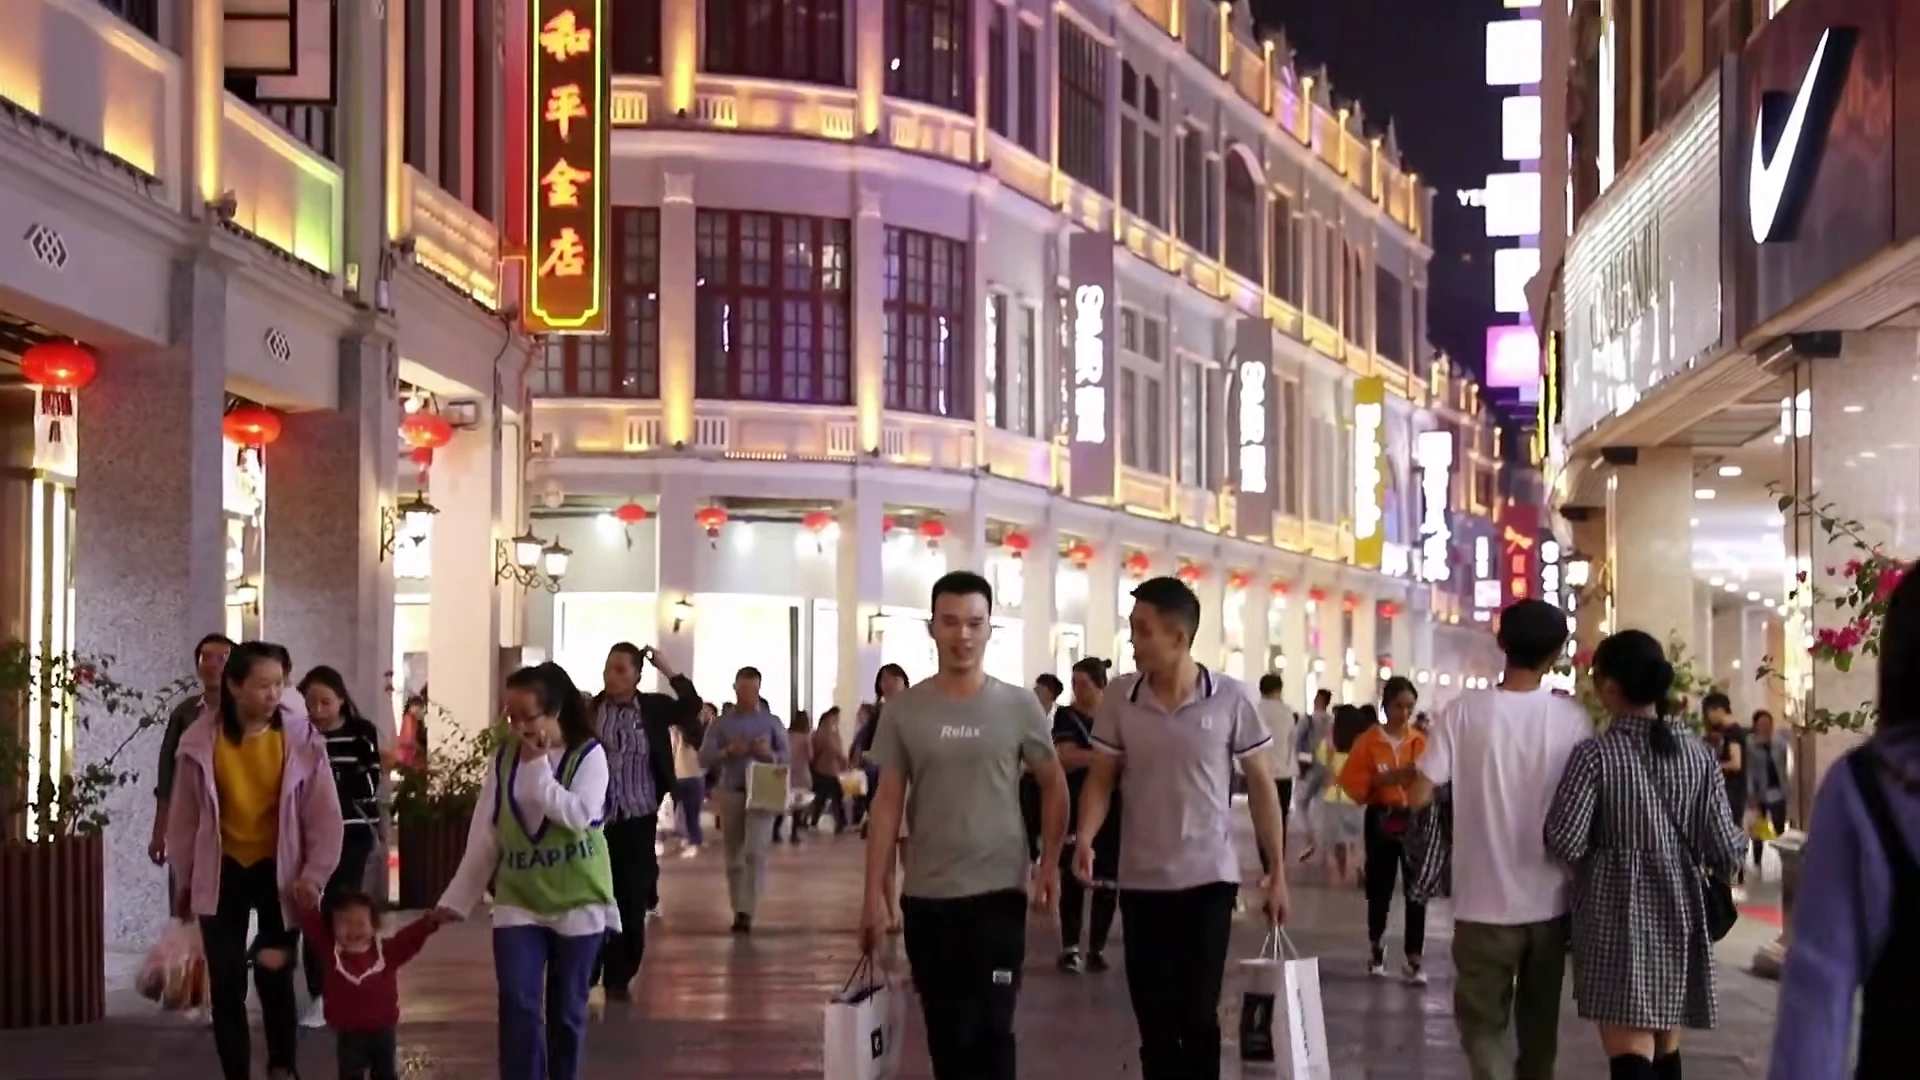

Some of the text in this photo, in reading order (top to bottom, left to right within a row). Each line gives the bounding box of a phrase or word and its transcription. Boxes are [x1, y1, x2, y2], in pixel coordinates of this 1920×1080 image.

[540, 9, 591, 277] 和平金店
[940, 724, 980, 739] Relax
